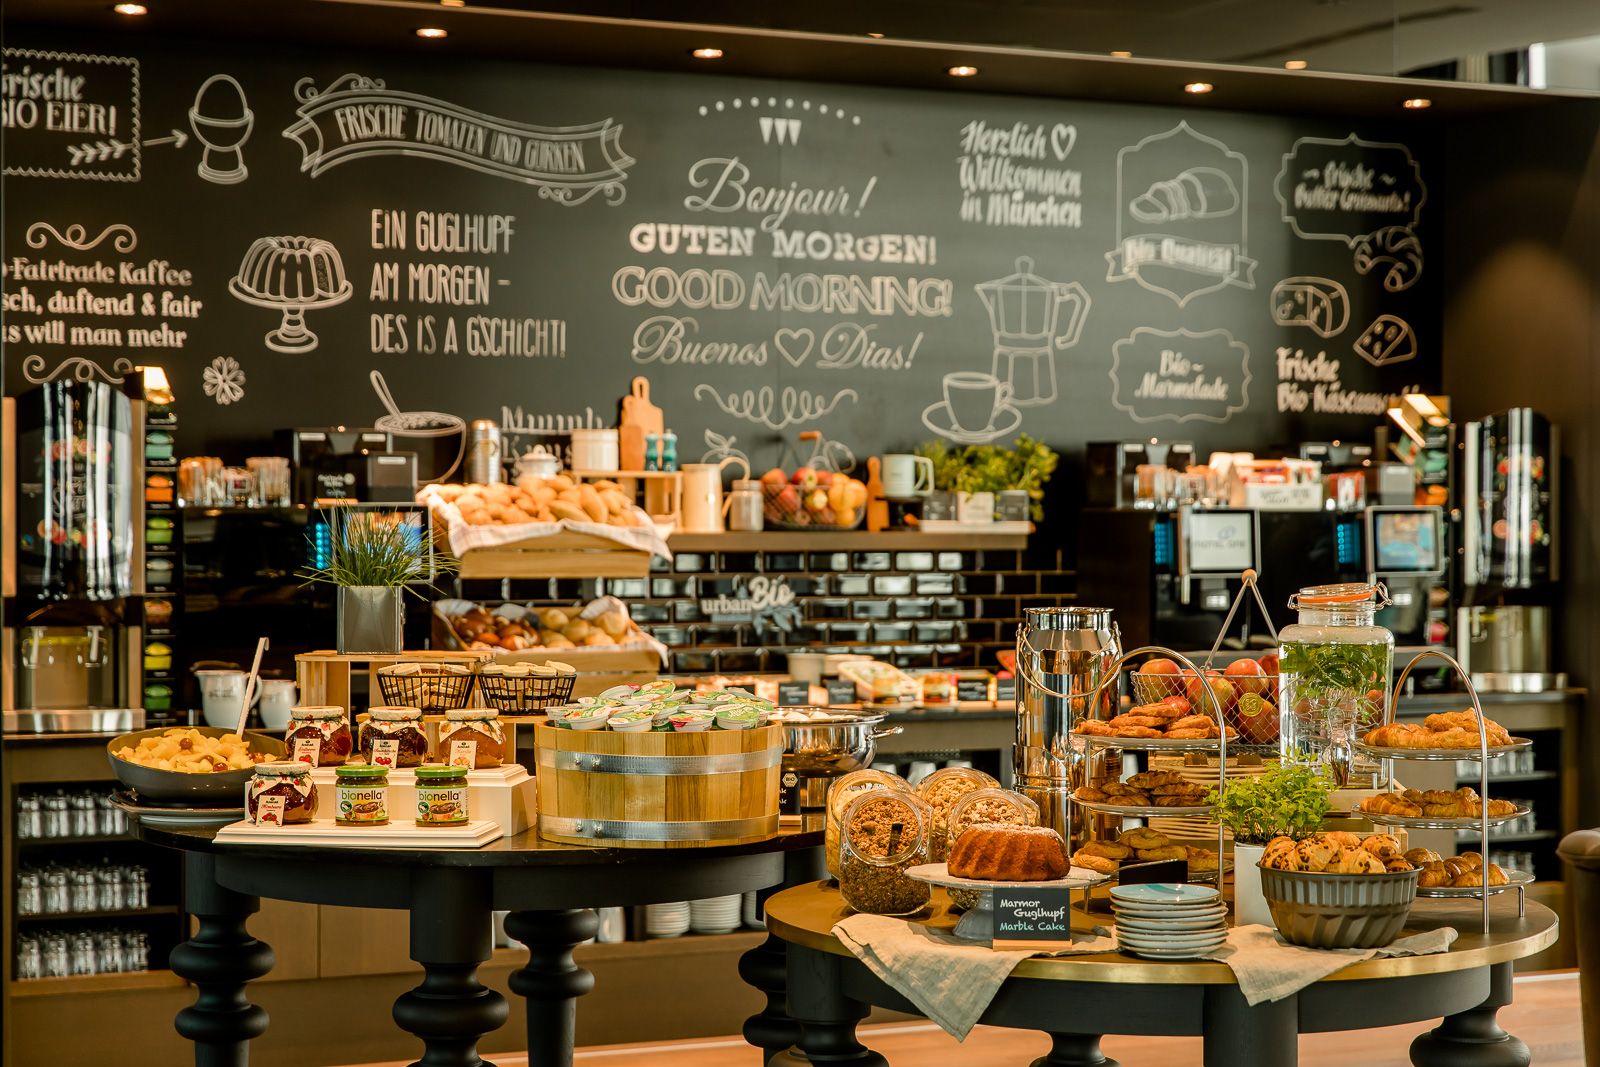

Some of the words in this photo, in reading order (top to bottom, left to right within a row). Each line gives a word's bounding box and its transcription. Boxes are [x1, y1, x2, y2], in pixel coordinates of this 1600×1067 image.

[46, 100, 117, 137] EIER!
[334, 104, 408, 142] FRISCHE
[415, 109, 488, 157] TOMATEN
[489, 130, 522, 165] UND
[523, 138, 586, 173] GURKEN
[960, 119, 1047, 160] Herzlich
[956, 153, 1082, 197] Willkommen
[683, 156, 878, 233] Bonjour!
[960, 190, 982, 222] in
[986, 190, 1082, 228] München
[416, 211, 516, 254] GUGLHUPF
[629, 222, 756, 256] GUTEN
[772, 228, 937, 264] MORGEN!
[119, 259, 192, 286] Kaffee
[370, 262, 399, 301] AM
[408, 263, 489, 305] MORGEN
[612, 266, 745, 309] GOOD
[750, 271, 953, 317] MORNING!
[48, 287, 135, 316] duftend
[141, 292, 156, 316] &
[160, 291, 203, 318] fair
[24, 320, 66, 344] will
[70, 326, 123, 346] man
[128, 322, 187, 348] mehr
[371, 313, 408, 353] DES
[443, 316, 459, 354] A
[631, 315, 767, 366] Buenos
[815, 321, 924, 369] Dias!
[701, 594, 752, 614] urban
[749, 576, 795, 610] Bio
[341, 790, 382, 800] bionella
[419, 791, 460, 801] bionella
[1000, 899, 1040, 908] Marmor
[1013, 906, 1065, 922] Guglhupf
[1000, 920, 1034, 931] Marble
[1037, 921, 1066, 931] Cake
